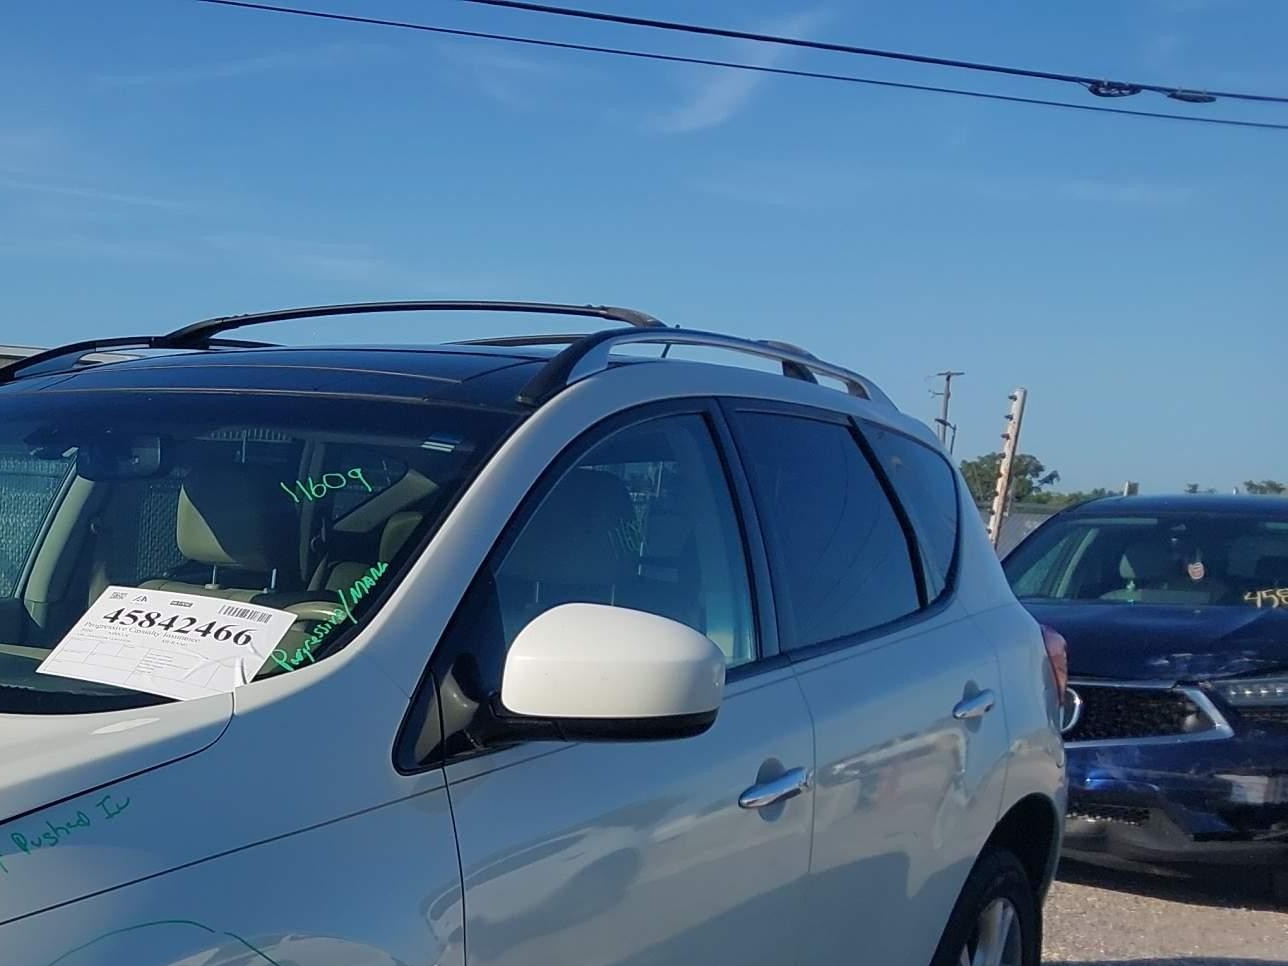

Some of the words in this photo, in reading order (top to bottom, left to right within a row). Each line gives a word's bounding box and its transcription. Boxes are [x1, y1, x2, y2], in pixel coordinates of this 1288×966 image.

[280, 467, 373, 503] 11609
[102, 606, 255, 646] 45842466
[11, 811, 91, 855] Pushed
